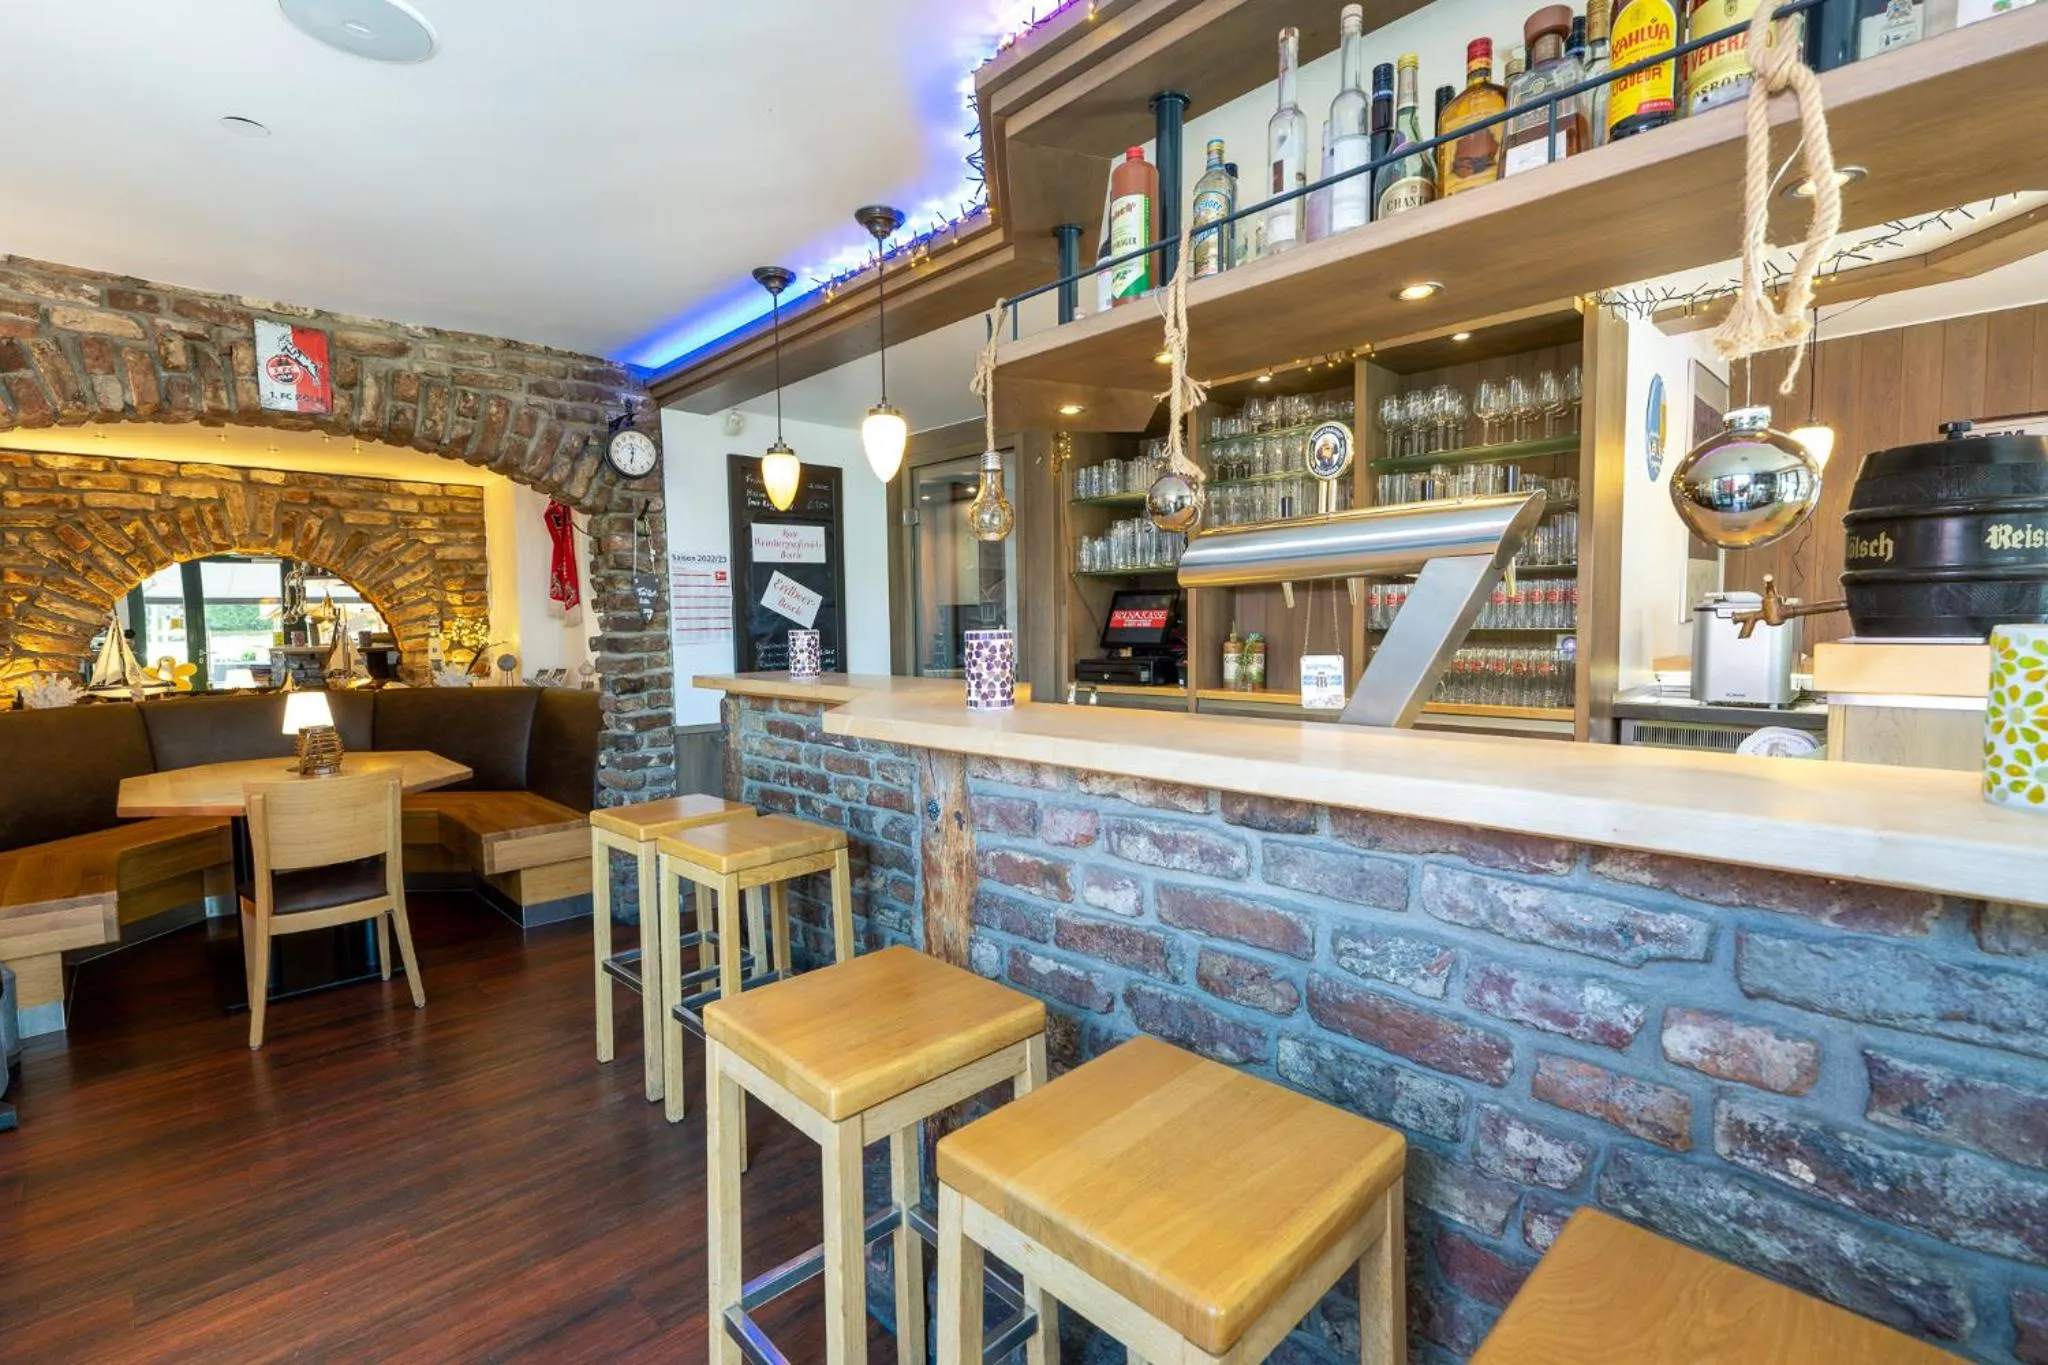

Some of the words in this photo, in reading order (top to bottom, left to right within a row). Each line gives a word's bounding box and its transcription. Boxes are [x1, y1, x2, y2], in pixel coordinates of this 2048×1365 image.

[280, 391, 294, 401] FC
[1846, 530, 1895, 563] ölsch
[671, 553, 696, 562] Saison
[697, 554, 728, 563] 2022/23
